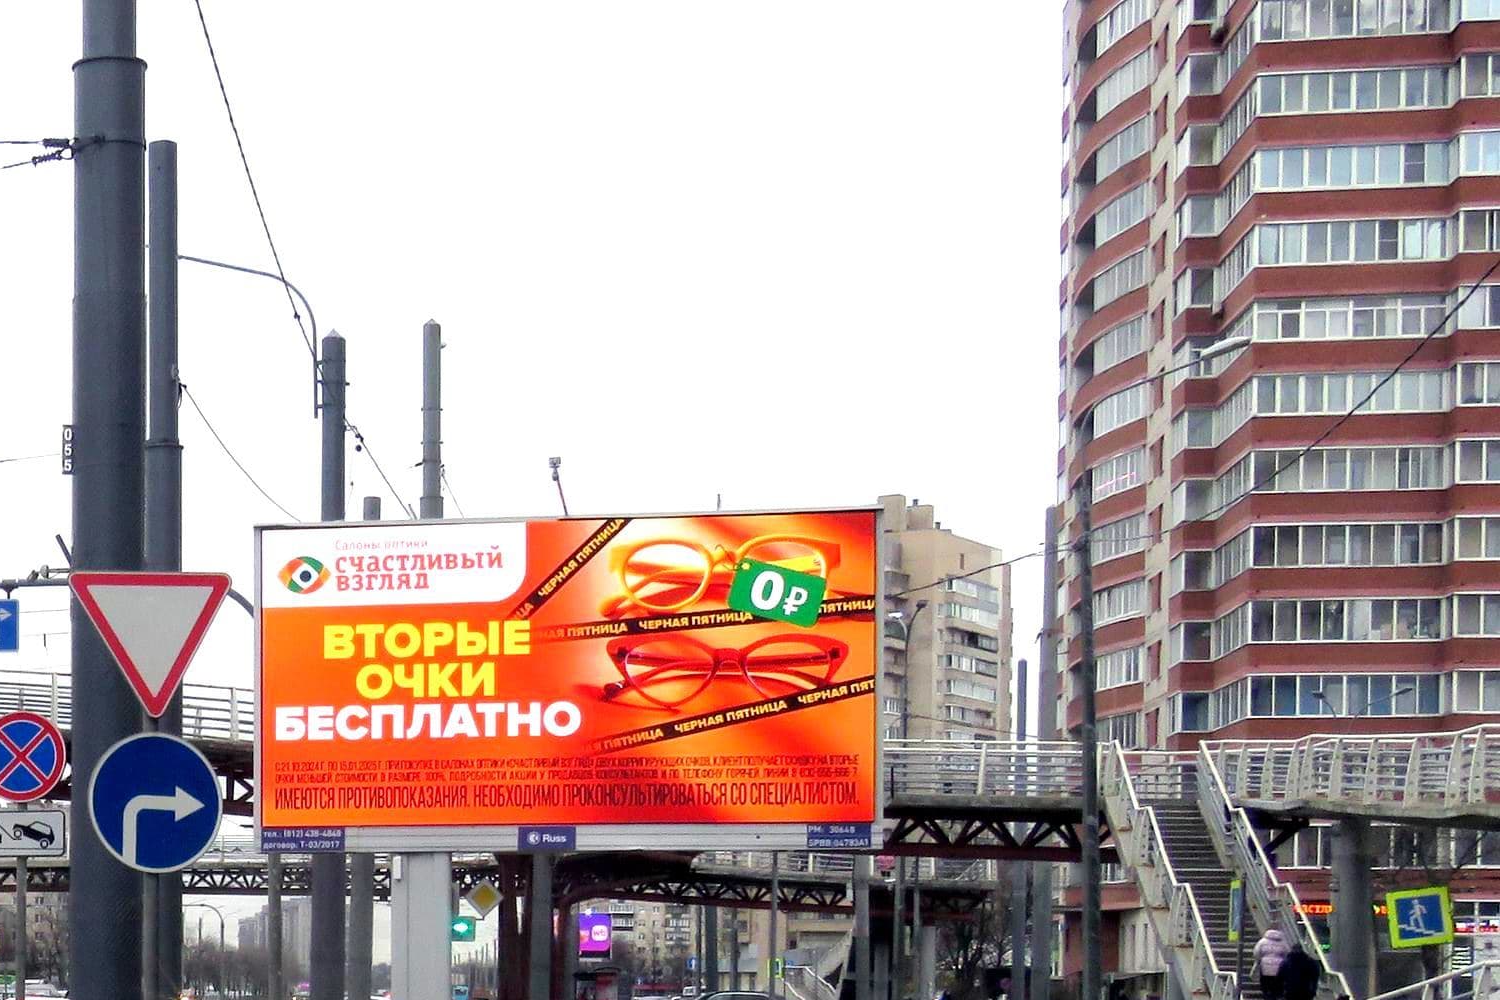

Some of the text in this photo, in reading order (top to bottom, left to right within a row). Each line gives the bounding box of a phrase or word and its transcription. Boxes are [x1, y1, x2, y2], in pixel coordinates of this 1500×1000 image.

[64, 428, 72, 472] 055
[538, 519, 625, 597] ЧЕРНАЯ ПЯТНИЦА
[323, 620, 531, 660] ВТОРЫЕ
[567, 622, 628, 638] ПЯТНИЦА
[639, 617, 690, 630] ЧЕРНАЯ
[691, 611, 753, 627] ПЯТНИЦА
[356, 662, 496, 700] ОЧКИ
[275, 701, 581, 741] БЕСПЛАТНО
[603, 728, 664, 750] ПЯТНИЦА
[674, 714, 724, 734] ЧЕРНАЯ
[726, 700, 787, 722] ПЯТНИЦА
[797, 685, 848, 705] ЧЕРНАЯ
[275, 781, 860, 809] ИМЕЮТСЯ ПРОТИВОПОКАЗАНИЯ. НЕОБХОДИМО ПРОКОНСУЛЬТИРОВАТЬСЯ СО СПЕЦИАЛИСТОМ.
[542, 833, 567, 843] Russ
